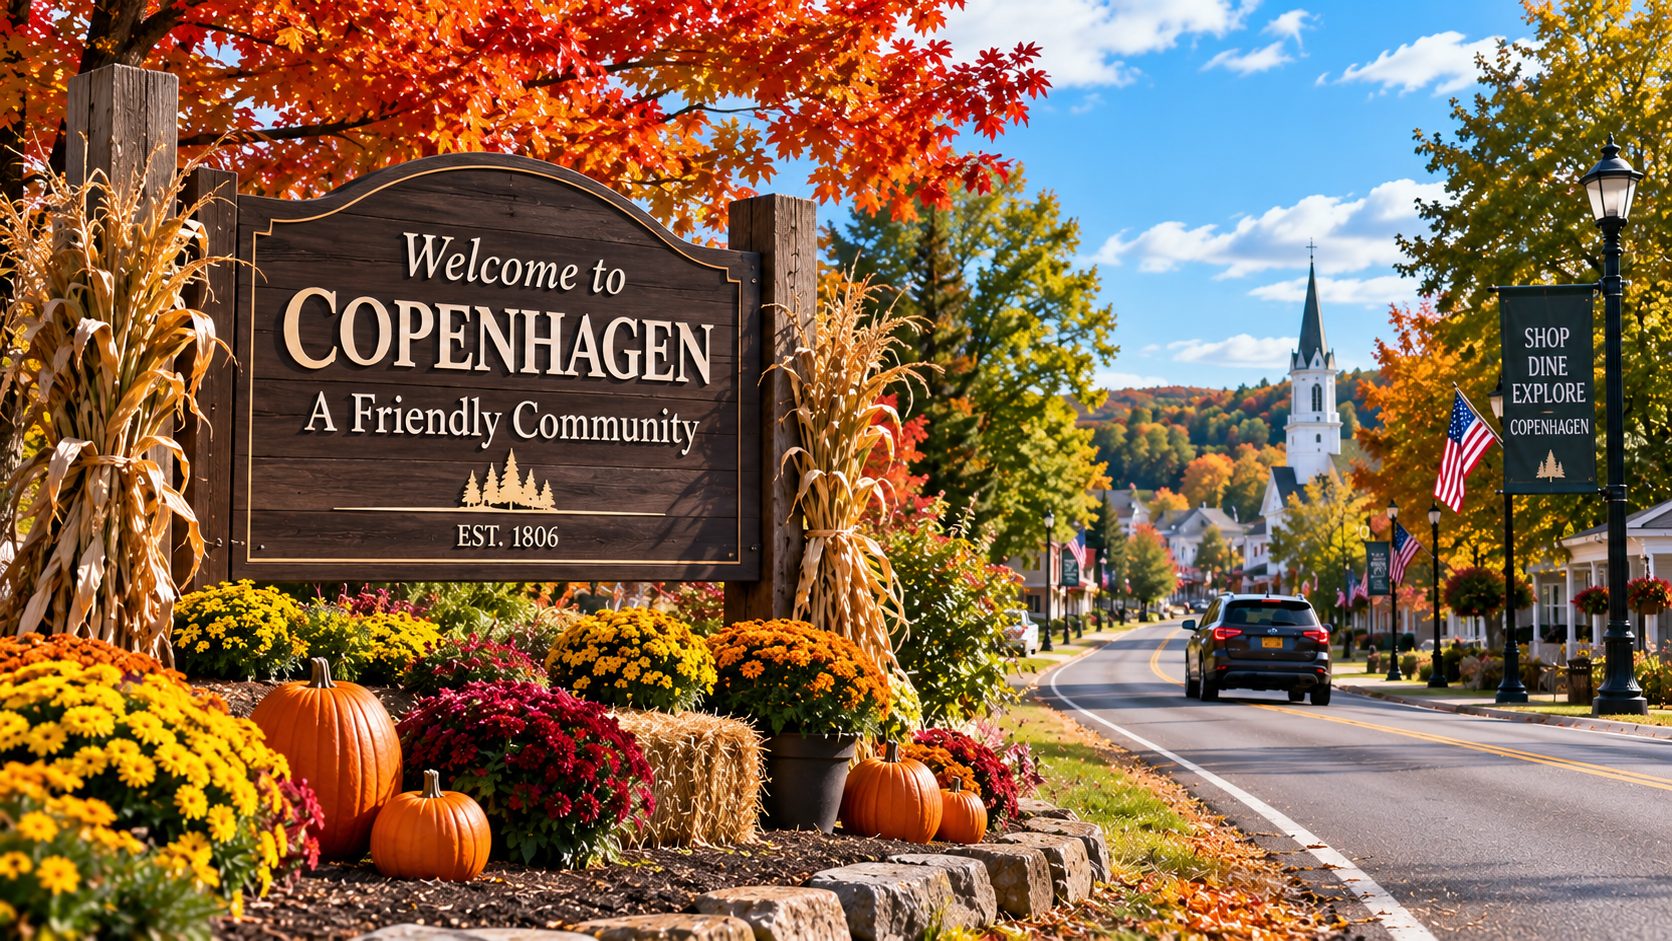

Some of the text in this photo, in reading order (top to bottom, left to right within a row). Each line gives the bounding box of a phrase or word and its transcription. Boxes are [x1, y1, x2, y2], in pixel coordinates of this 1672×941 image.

[403, 232, 626, 295] Welcome to
[283, 287, 714, 385] COPENHAGEN
[1524, 327, 1570, 348] SHOP
[1528, 356, 1568, 376] DINE
[1512, 382, 1586, 404] EXPLORE
[304, 390, 700, 455] A Friendly Community
[1510, 418, 1589, 436] COPENHAGEN
[457, 524, 559, 548] EST. 1806
